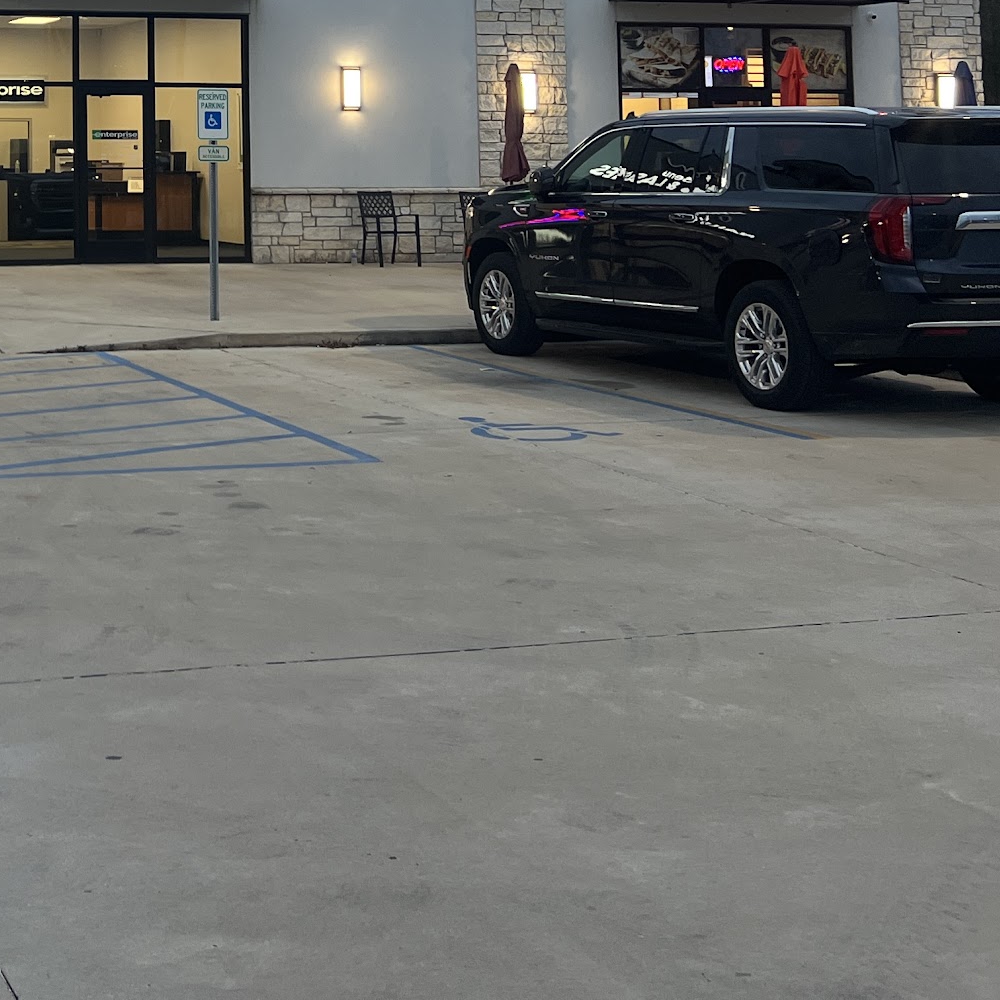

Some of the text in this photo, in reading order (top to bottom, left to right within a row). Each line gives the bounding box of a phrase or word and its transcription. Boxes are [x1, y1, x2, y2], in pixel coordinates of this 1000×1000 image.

[713, 58, 745, 71] OPEN
[199, 93, 227, 101] RESERVED
[93, 131, 138, 139] enterprise
